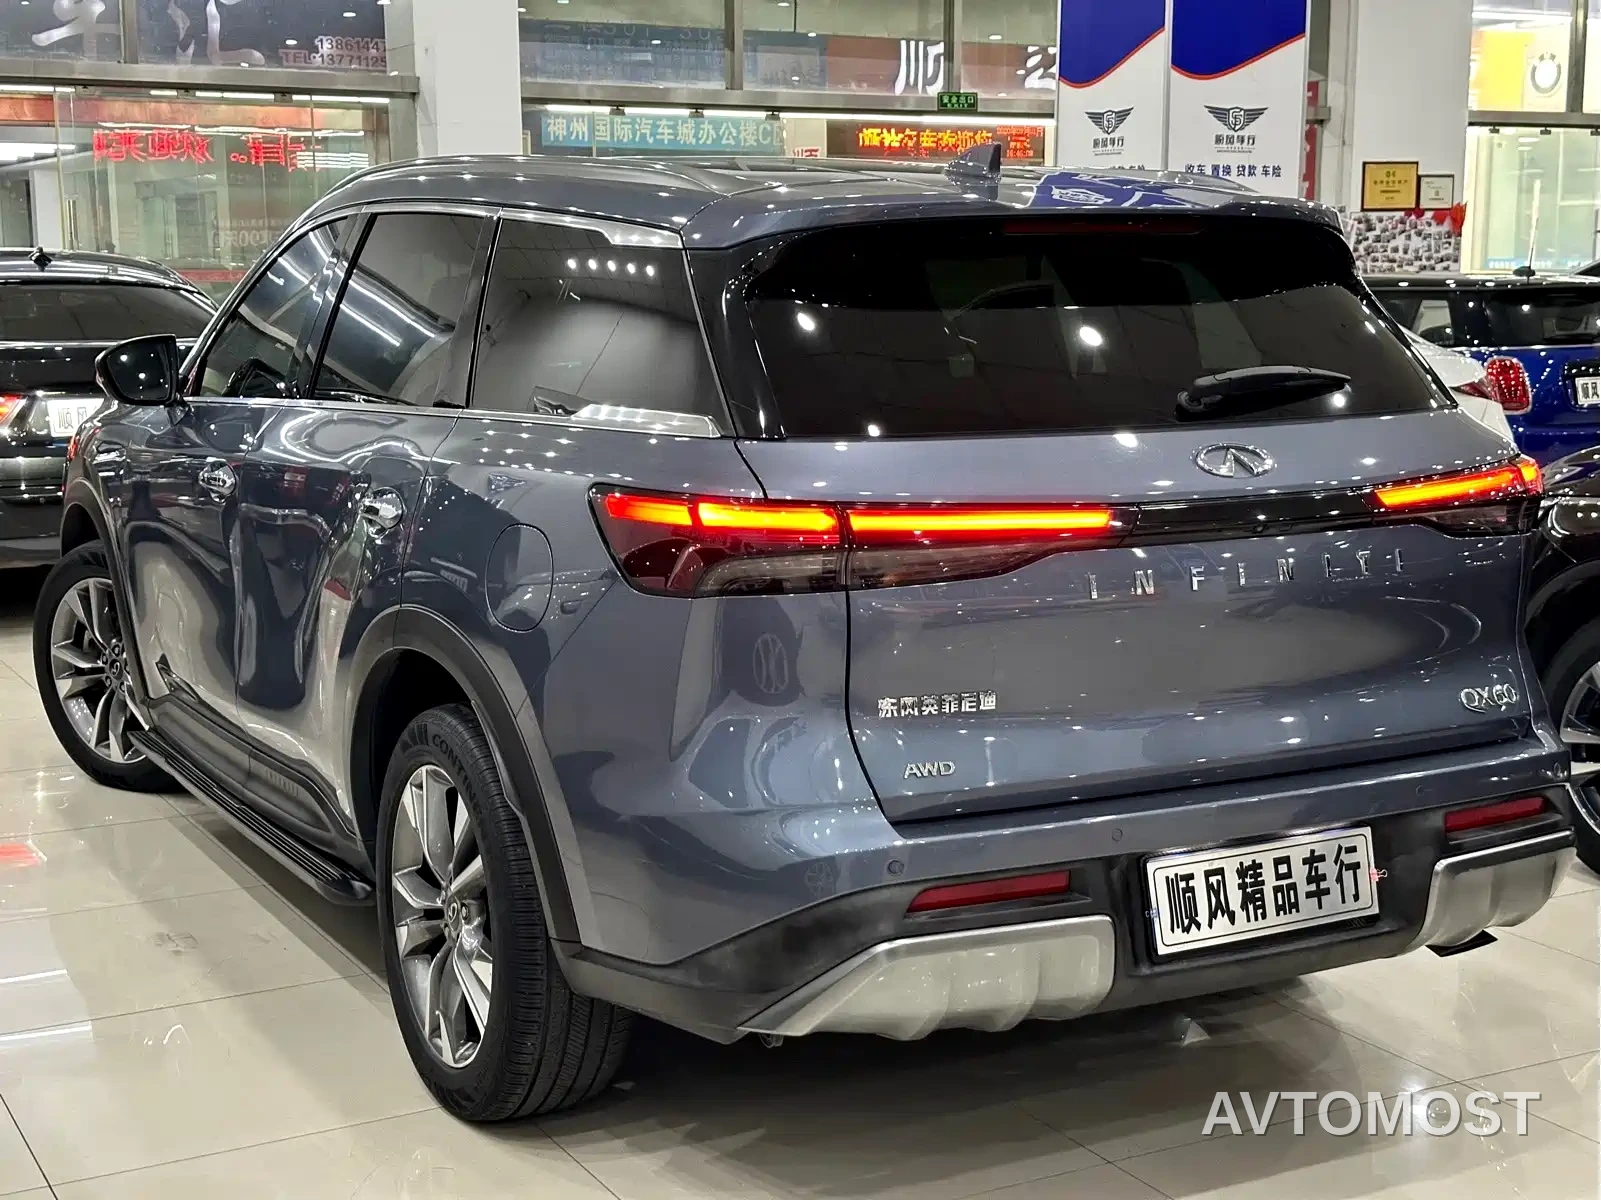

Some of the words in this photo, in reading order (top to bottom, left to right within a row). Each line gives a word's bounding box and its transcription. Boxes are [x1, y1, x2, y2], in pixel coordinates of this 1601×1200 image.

[941, 95, 974, 104] 安全出口
[1184, 164, 1206, 174] 收车
[1211, 164, 1232, 177] 置换
[1237, 164, 1257, 177] 贷款
[1261, 165, 1282, 177] 车险
[1087, 549, 1404, 600] INFINITI
[878, 690, 997, 718] 东风英菲尼迪
[1460, 684, 1517, 713] QX60
[904, 761, 956, 779] AWD
[1165, 843, 1362, 935] 顺风精品车行
